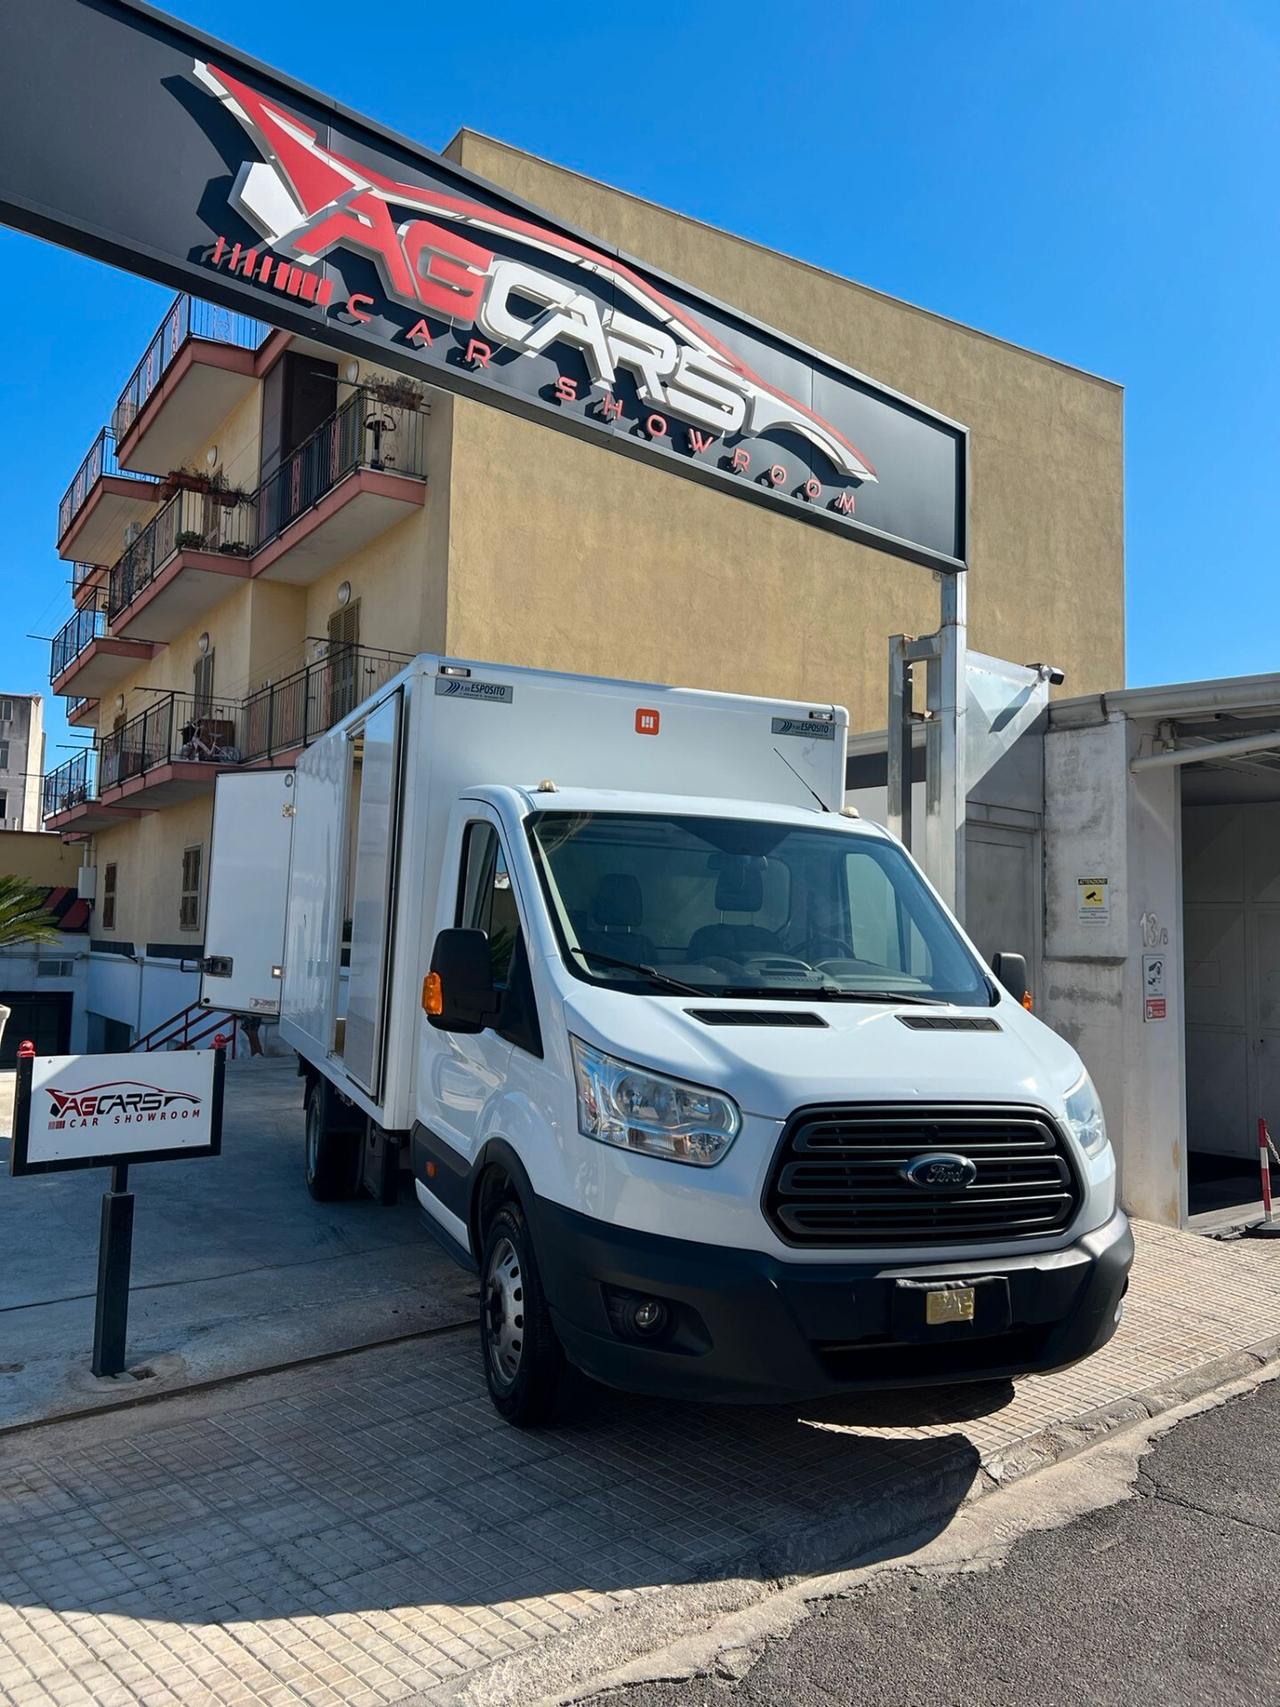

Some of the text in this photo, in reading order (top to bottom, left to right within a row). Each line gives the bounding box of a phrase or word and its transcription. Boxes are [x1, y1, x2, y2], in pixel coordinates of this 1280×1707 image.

[345, 294, 856, 513] CAR SHOWROOM
[471, 684, 505, 696] ESPOSITO
[70, 1109, 200, 1128] CAR SHOWROOM
[927, 1164, 964, 1182] Ford
